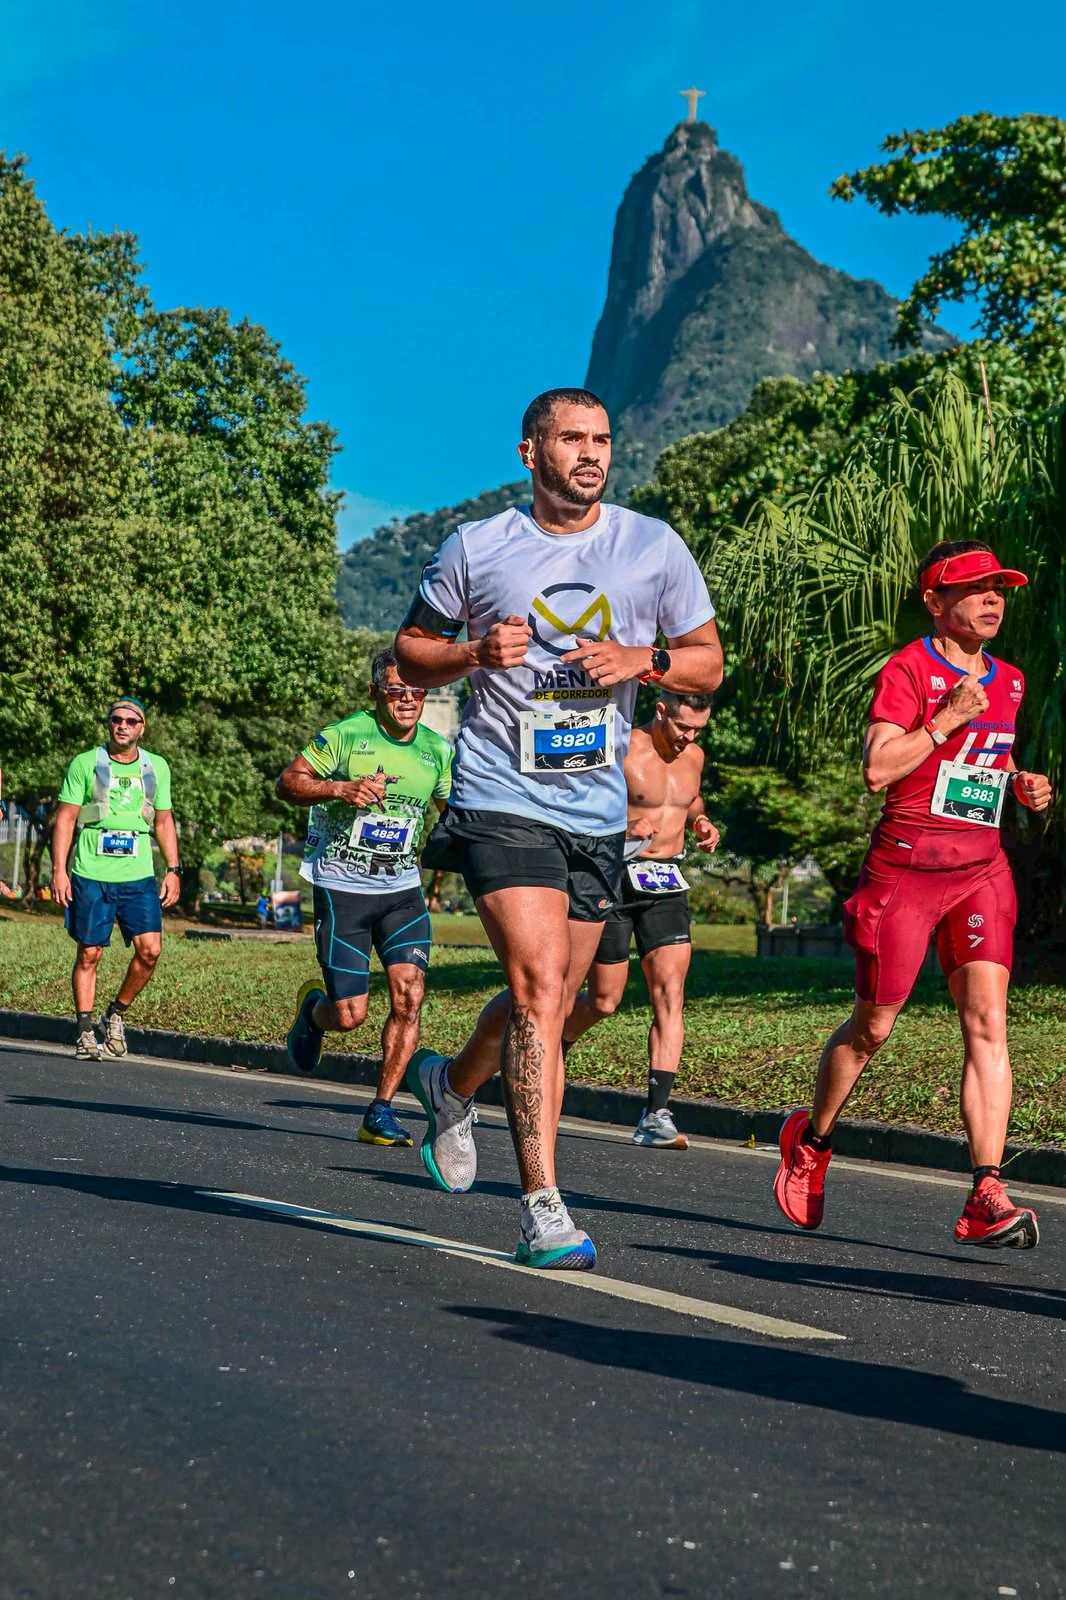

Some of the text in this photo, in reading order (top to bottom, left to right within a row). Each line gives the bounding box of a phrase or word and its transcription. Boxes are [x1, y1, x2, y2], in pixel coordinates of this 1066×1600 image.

[535, 689, 610, 700] DE CORREDOR
[550, 731, 596, 748] 3920
[960, 786, 994, 803] 9383
[371, 828, 400, 840] 4824
[334, 846, 367, 864] TONA
